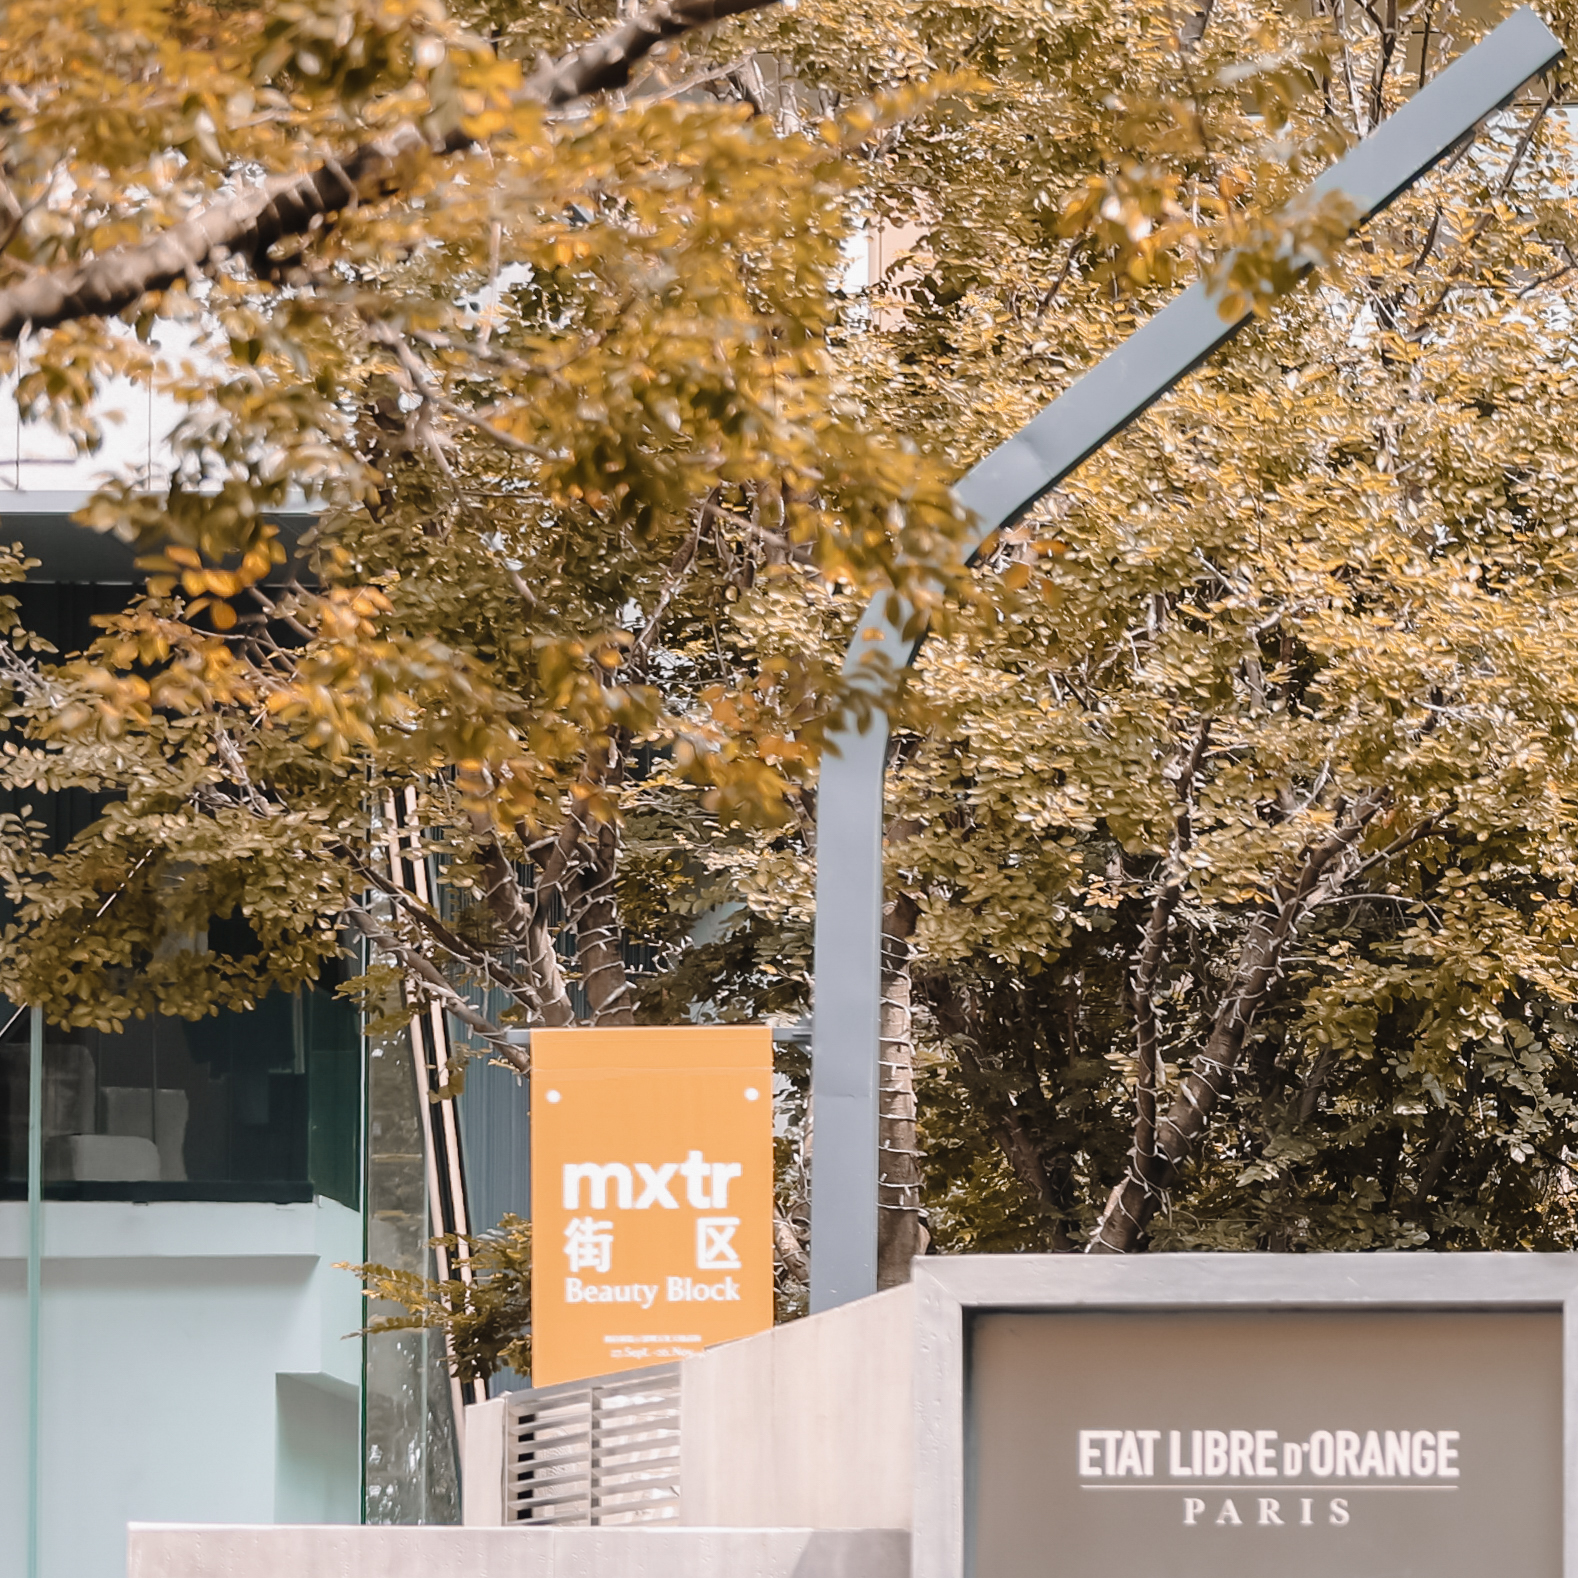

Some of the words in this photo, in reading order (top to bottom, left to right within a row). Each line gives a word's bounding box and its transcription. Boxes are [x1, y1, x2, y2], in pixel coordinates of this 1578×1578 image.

[562, 1150, 742, 1210] mxtr
[564, 1277, 658, 1309] Beauty
[666, 1276, 741, 1302] Block
[1079, 1430, 1160, 1476] ETAT
[1170, 1430, 1278, 1476] LIBRE
[1183, 1498, 1351, 1525] PARIS
